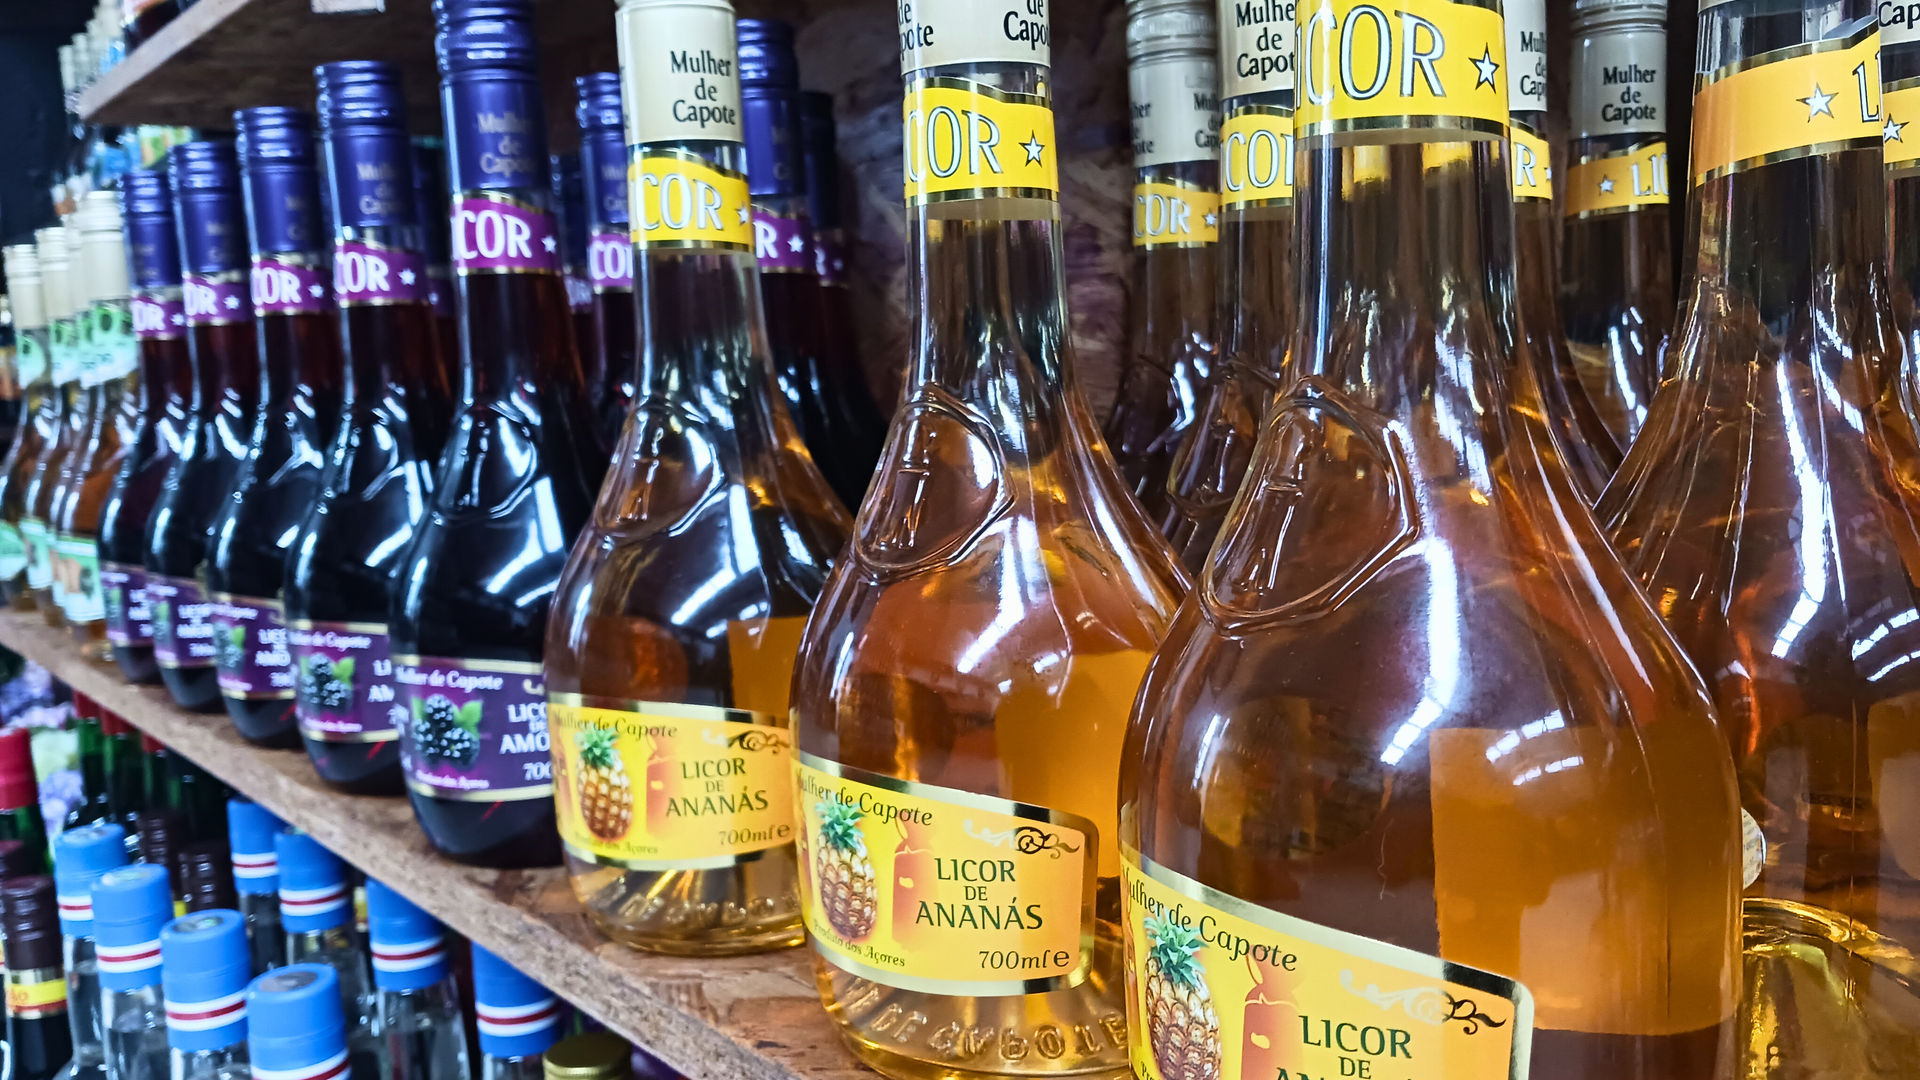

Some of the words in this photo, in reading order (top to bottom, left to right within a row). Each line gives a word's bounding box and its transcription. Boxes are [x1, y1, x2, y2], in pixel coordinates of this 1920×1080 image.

[1256, 28, 1283, 51] de
[670, 49, 732, 77] Mulher
[1602, 64, 1657, 86] Mulher
[694, 77, 718, 102] de
[1620, 86, 1642, 104] de
[672, 99, 736, 128] Capote
[1601, 103, 1657, 125] Capote
[682, 757, 747, 780] LICOR
[705, 780, 725, 794] DE
[666, 786, 770, 817] ANANÁS
[835, 786, 854, 808] de
[860, 792, 934, 827] Capote
[934, 857, 1017, 883] LICOR
[965, 885, 989, 902] DE
[915, 895, 1044, 931] ANANÁS
[1168, 903, 1192, 933] de
[1199, 915, 1298, 972] Capote
[978, 949, 1048, 970] 700ml
[1298, 1015, 1413, 1060] LICOR
[1337, 1056, 1372, 1080] DE
